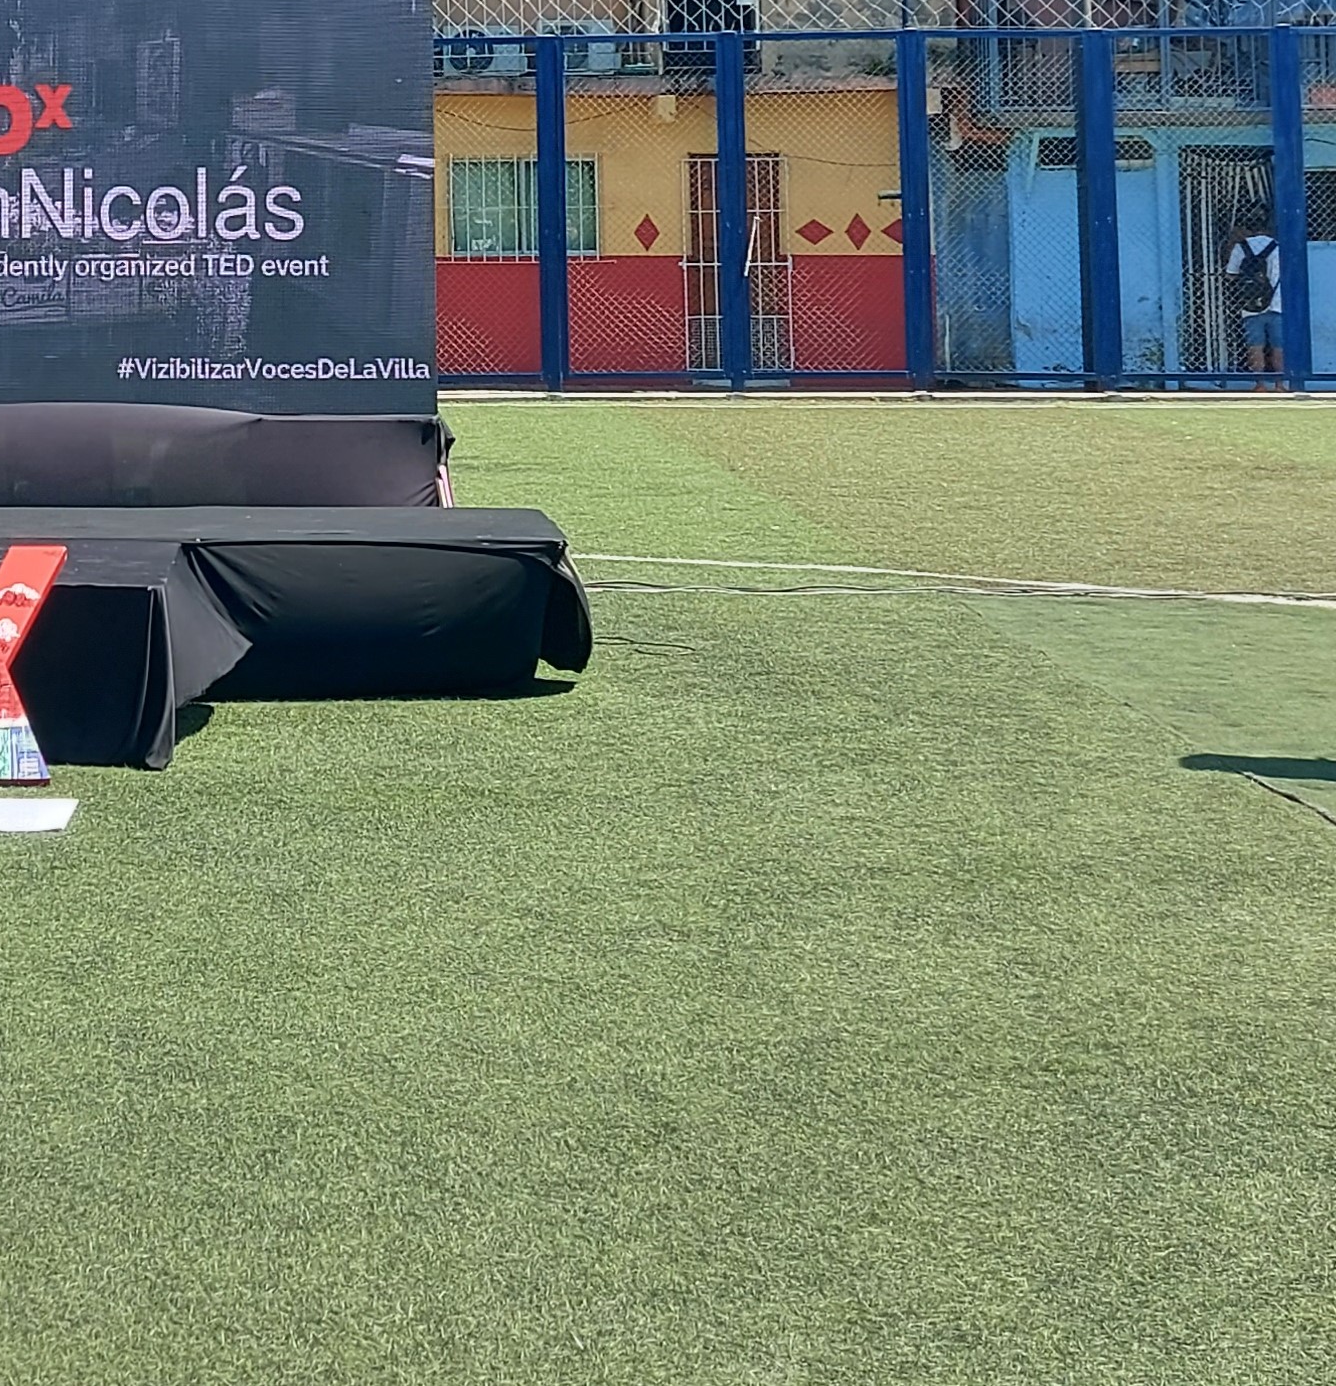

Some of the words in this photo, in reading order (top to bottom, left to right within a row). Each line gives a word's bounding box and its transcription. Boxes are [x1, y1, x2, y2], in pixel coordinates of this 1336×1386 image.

[75, 255, 195, 281] organized
[202, 254, 254, 276] TED
[261, 254, 330, 277] event
[117, 358, 431, 380] #VizibilizarVocesDeLaVilla
